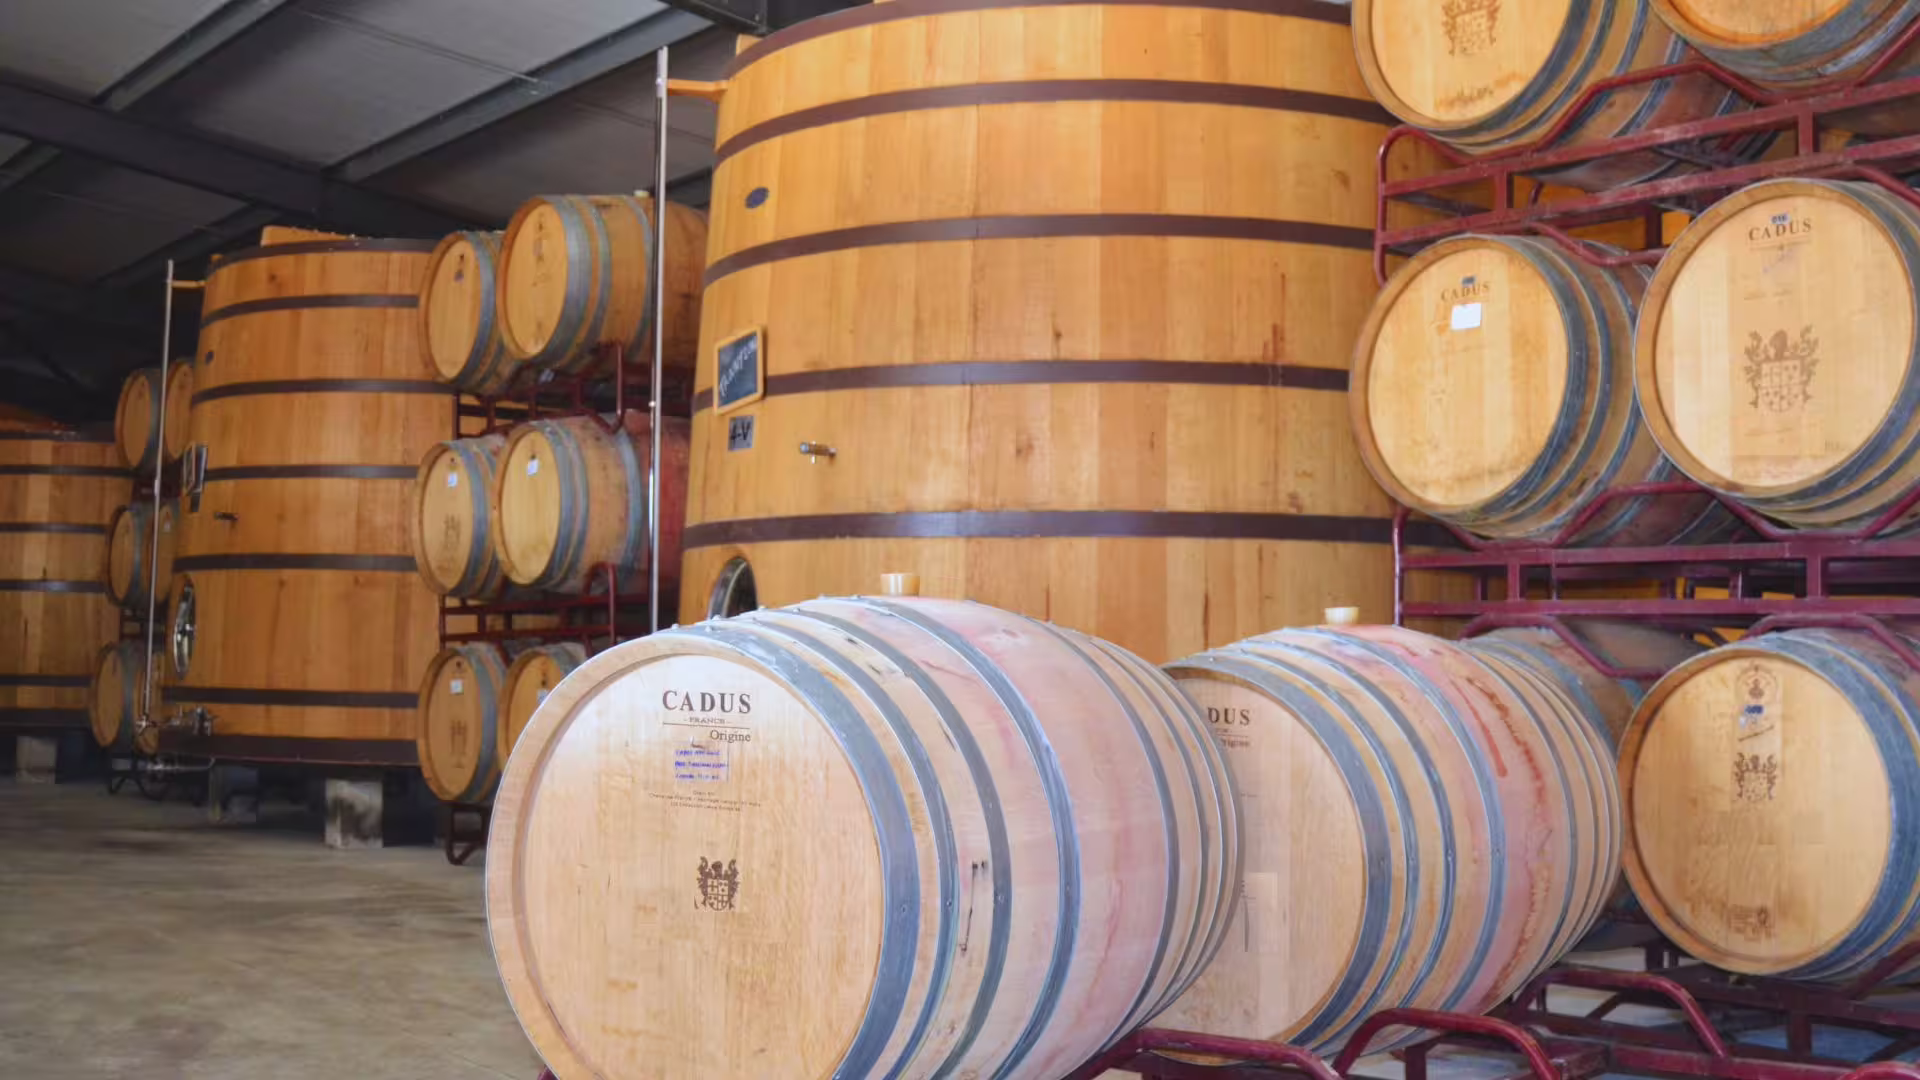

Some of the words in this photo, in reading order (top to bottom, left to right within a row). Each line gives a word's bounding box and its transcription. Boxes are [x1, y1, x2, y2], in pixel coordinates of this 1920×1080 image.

[1749, 217, 1811, 241] CADUS
[1441, 281, 1489, 301] CADUS
[662, 690, 751, 714] CADUS
[1207, 706, 1250, 726] DUS
[709, 730, 751, 743] Origine
